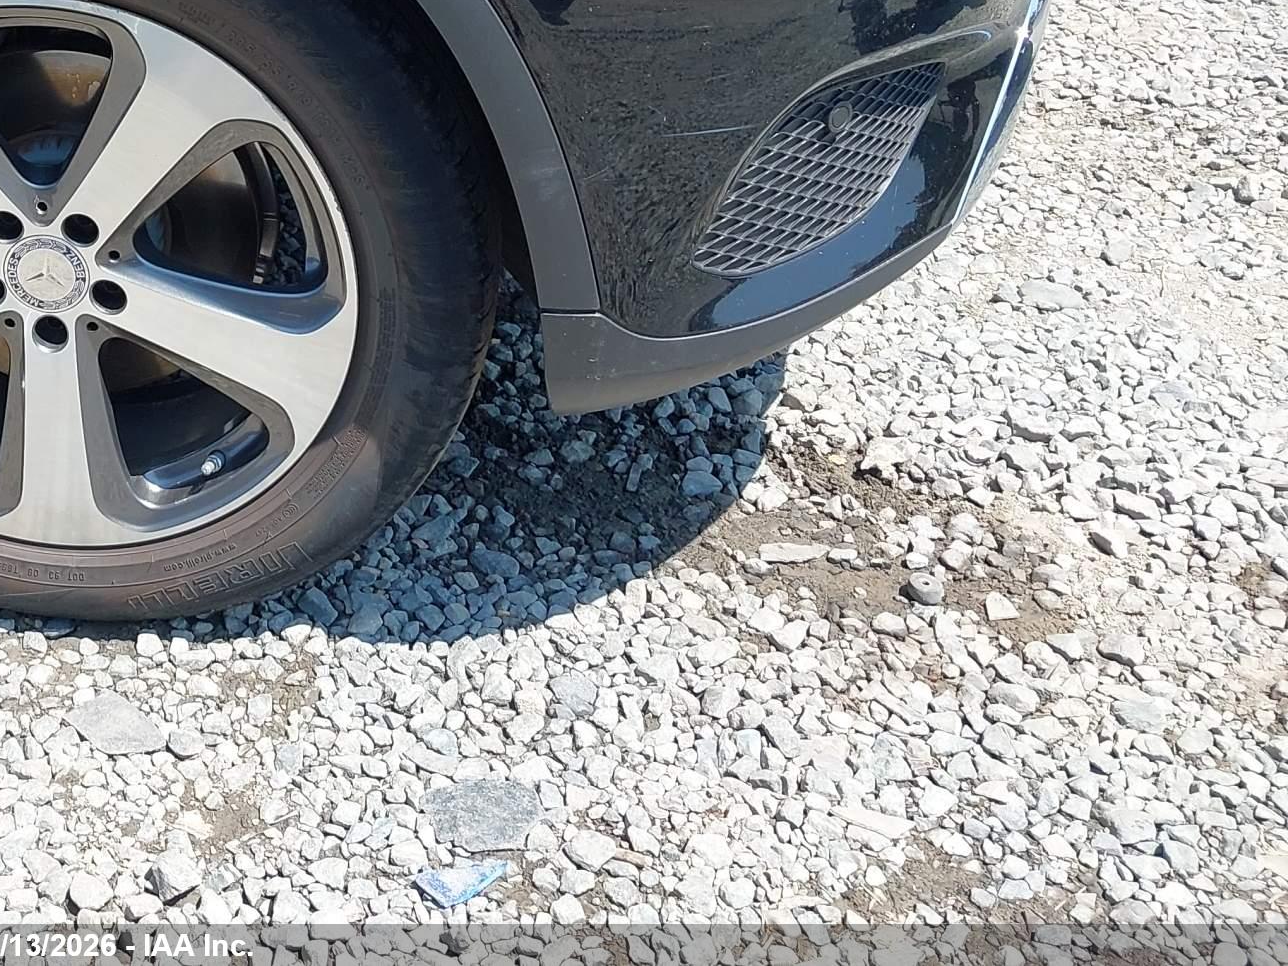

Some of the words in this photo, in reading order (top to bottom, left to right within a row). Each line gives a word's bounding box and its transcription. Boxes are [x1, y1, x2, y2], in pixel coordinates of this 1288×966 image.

[7, 257, 40, 307] MERCEDES
[65, 250, 86, 280] BENZ
[67, 571, 85, 583] DOT
